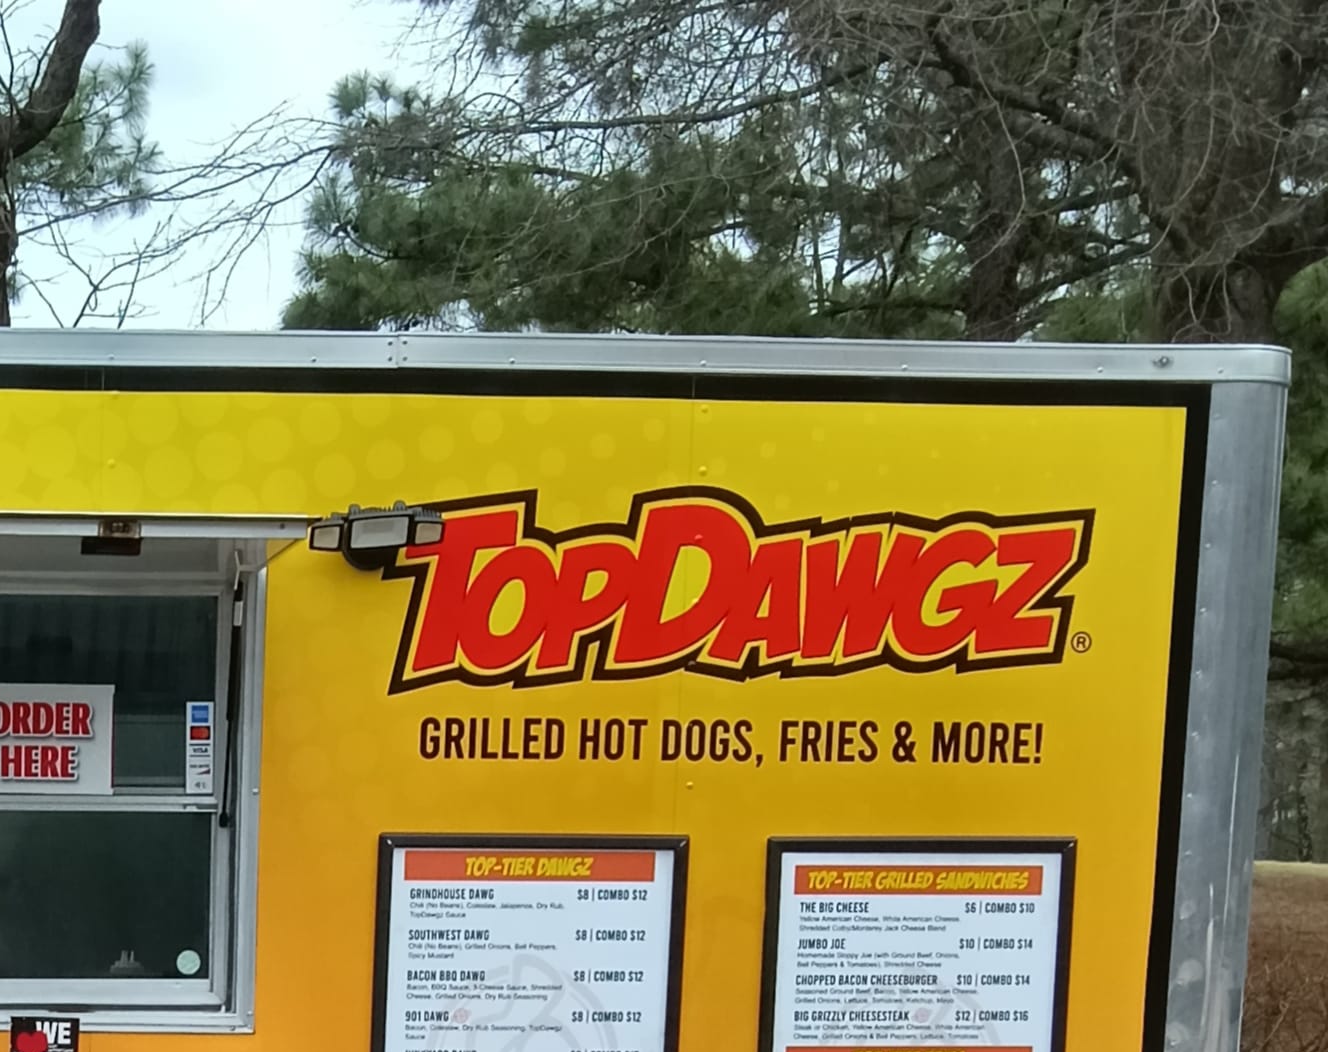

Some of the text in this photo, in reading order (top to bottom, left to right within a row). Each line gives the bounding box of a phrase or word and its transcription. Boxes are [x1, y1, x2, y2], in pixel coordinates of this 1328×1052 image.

[419, 717, 1043, 767] GRILLED HOT DOGS, FRIES & MORE!
[0, 745, 78, 780] HERE
[466, 857, 594, 876] TOP-TIER DAWGZ
[808, 871, 1029, 889] TOP-TIER GRILLED SANDWICHES
[410, 889, 494, 900] GRINDHOUSE DAWG
[577, 890, 648, 900] $8 COMBO $12
[800, 903, 869, 913] THE BIG CHEESE
[965, 903, 1035, 913] $6 COMBO $10
[409, 930, 490, 940] SOUTHWEST DAWG
[576, 930, 646, 941] $8 COMBO $12
[798, 939, 845, 949] JUMBO JOE
[960, 939, 1032, 950] $10 COMBO $14
[407, 971, 485, 981] BACON BBQ DAWG
[574, 971, 644, 982] $8 COMBO $12
[796, 975, 937, 985] CHOPPED BACON CHEESEBURGER
[957, 975, 1030, 986] $10 COMBO $14
[405, 1012, 449, 1022] 901 DAWG
[572, 1012, 642, 1022] $8 COMBO $12
[794, 1011, 909, 1022] BIG GRIZZLY CHEESESTEAK
[955, 1011, 1028, 1022] $12 COMBO $16
[36, 1021, 71, 1044] WE
